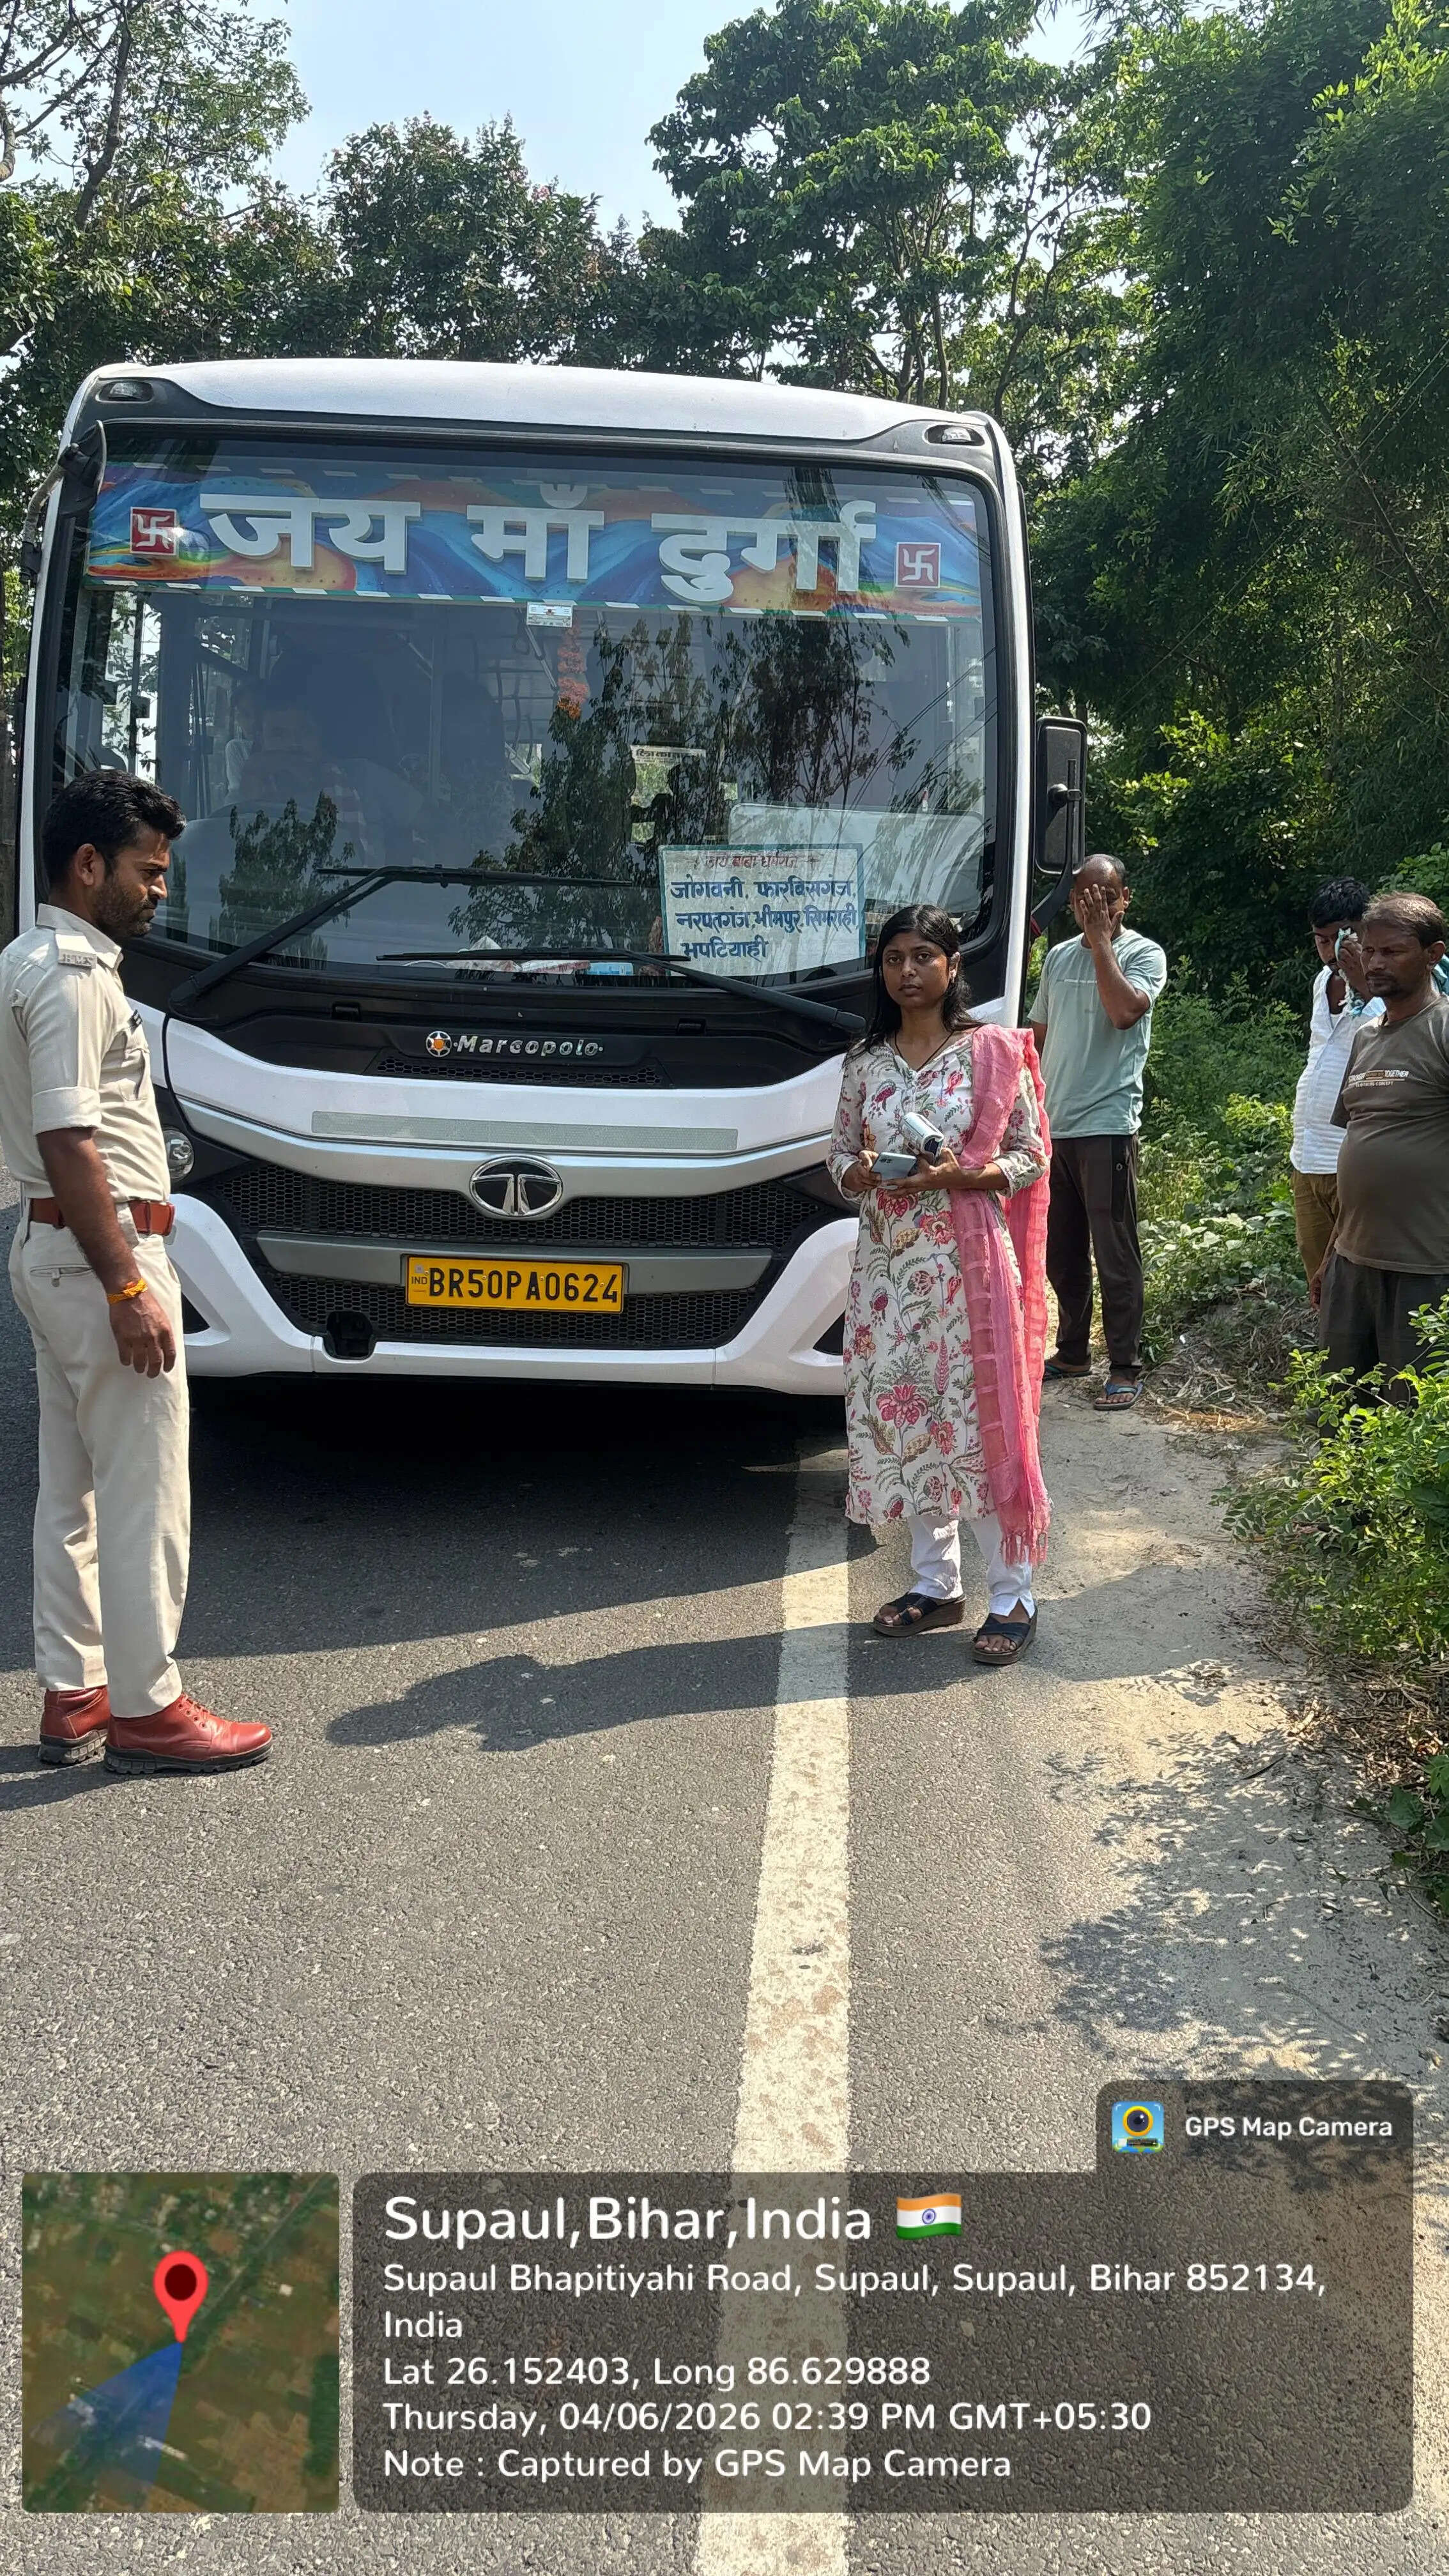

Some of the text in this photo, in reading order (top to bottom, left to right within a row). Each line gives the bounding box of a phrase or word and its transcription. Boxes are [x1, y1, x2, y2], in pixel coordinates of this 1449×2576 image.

[199, 493, 422, 575] जय
[650, 500, 877, 604] दुर्गा
[456, 1035, 599, 1056] Marcopolo
[411, 1276, 427, 1285] IND
[429, 1268, 617, 1304] BR50PA0624
